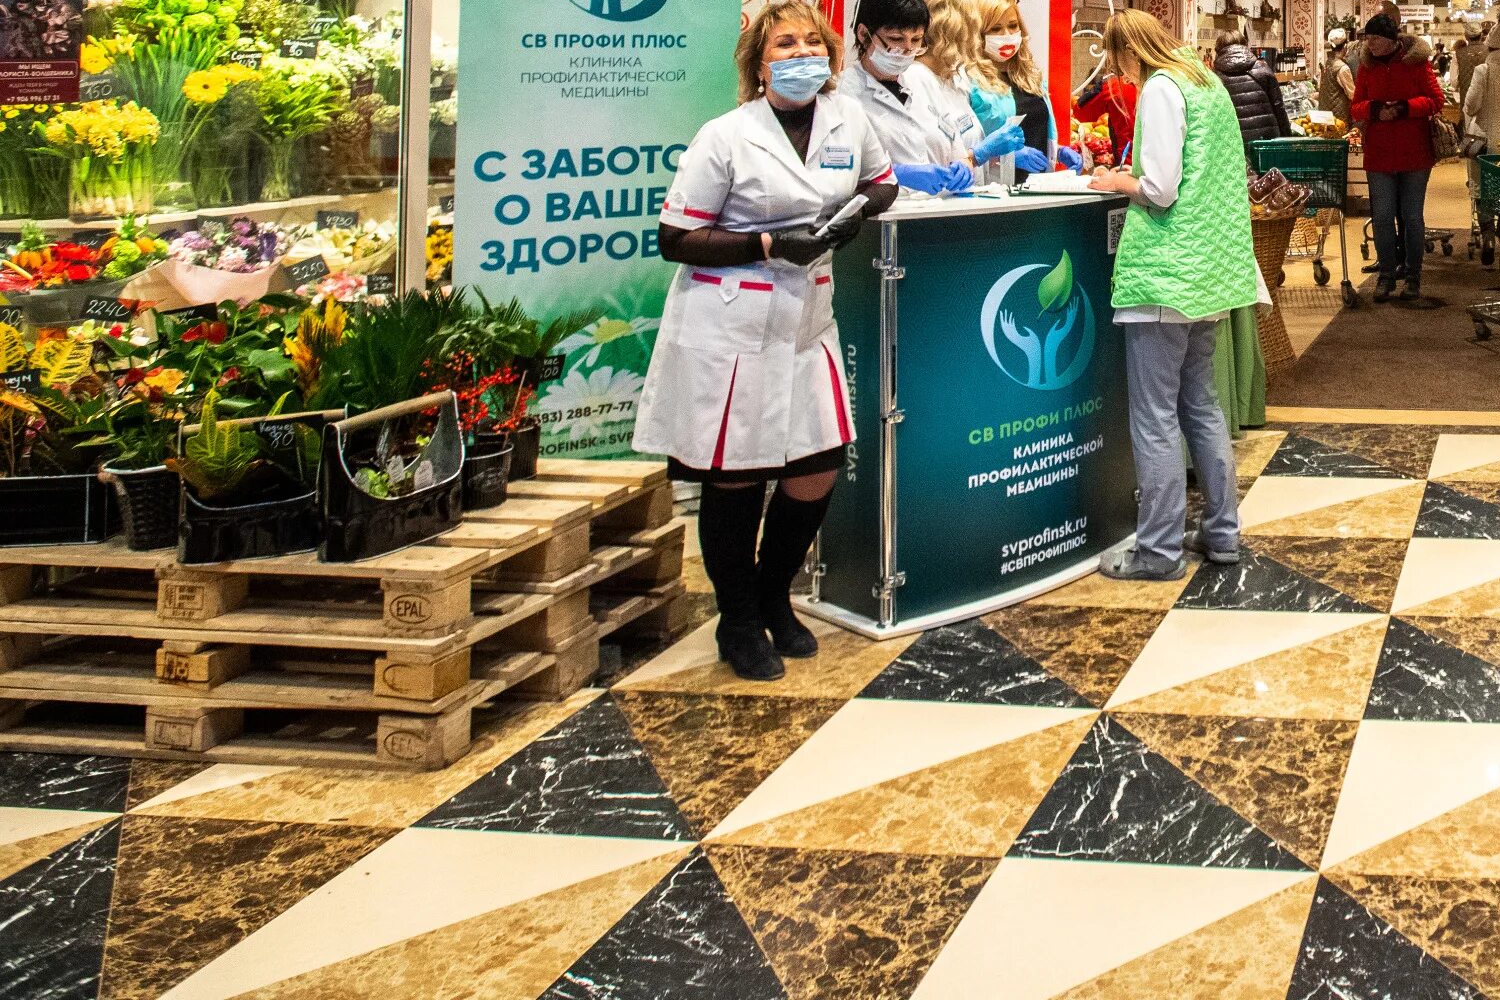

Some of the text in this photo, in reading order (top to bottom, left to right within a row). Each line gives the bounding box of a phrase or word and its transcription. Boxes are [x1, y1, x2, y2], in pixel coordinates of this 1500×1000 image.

[521, 33, 688, 50] СВ ПРОФИ ПЛЮС
[520, 69, 687, 84] ПРОФИЛАКТИЧЕСКОЙ
[569, 56, 643, 69] КЛИНИКА
[561, 86, 649, 98] МЕДИЦИНЫ
[474, 145, 687, 182] С ЗАБОТО
[494, 191, 668, 225] О ВАШЕ
[480, 230, 662, 274] ЗДОРОВ
[567, 401, 633, 420] 288-77-77
[968, 395, 1103, 446] СВ ПРОФИ ПЛЮС
[609, 431, 634, 444] SVP
[1013, 433, 1074, 459] КЛИНИКА
[968, 435, 1104, 489] ПРОФИЛАКТИЧЕСКОЙ
[1006, 464, 1079, 497] МЕДИЦИНЫ
[1001, 516, 1087, 556] svprofinsk.ru
[1000, 533, 1087, 575] #СВПРОФИПЛЮС
[396, 600, 426, 617] EPAL
